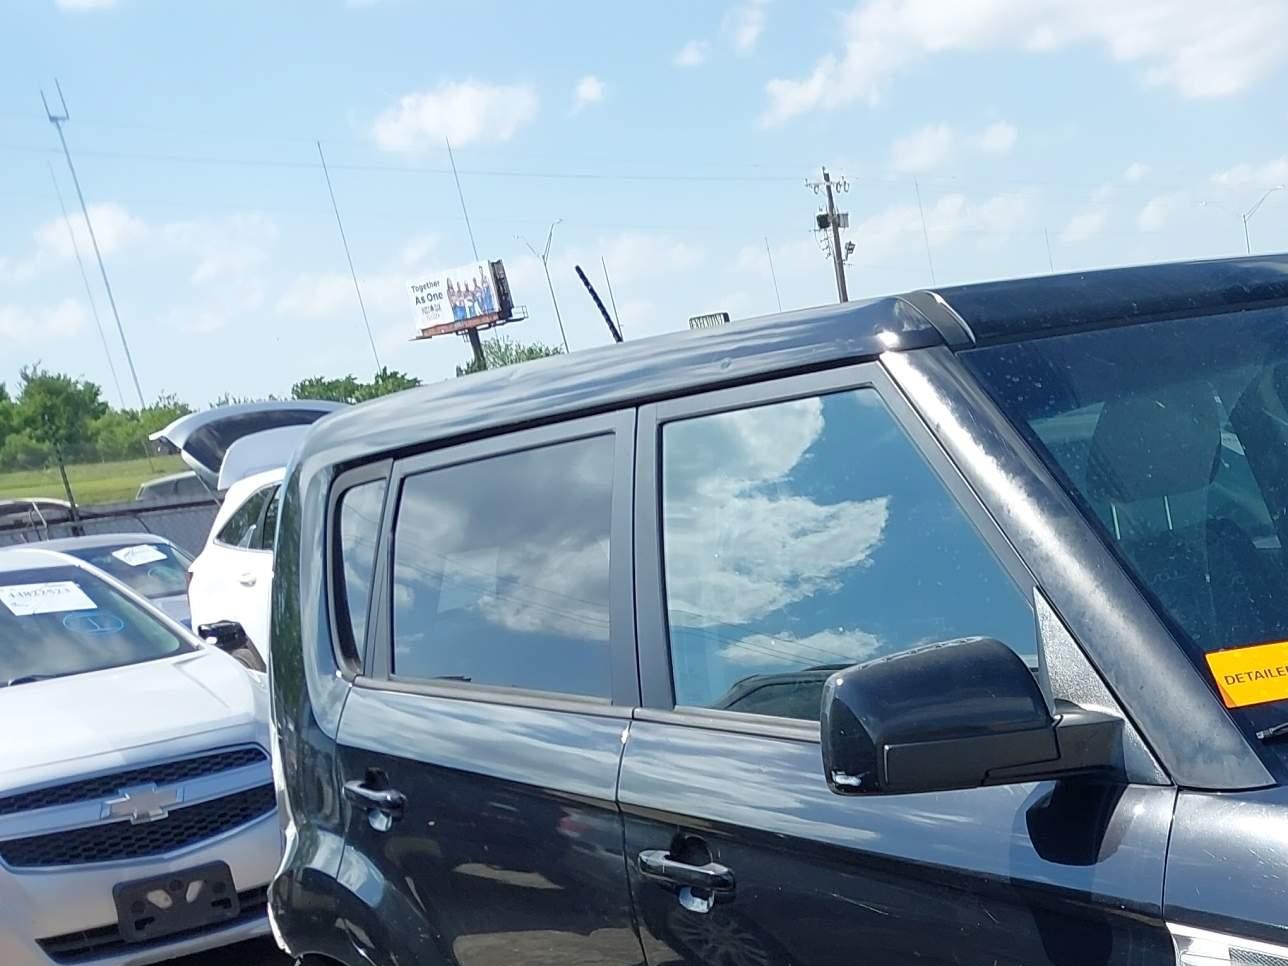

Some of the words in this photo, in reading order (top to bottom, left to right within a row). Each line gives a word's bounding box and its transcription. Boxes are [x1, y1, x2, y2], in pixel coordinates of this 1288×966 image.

[410, 280, 441, 293] Together
[415, 295, 426, 306] As
[426, 291, 444, 302] One
